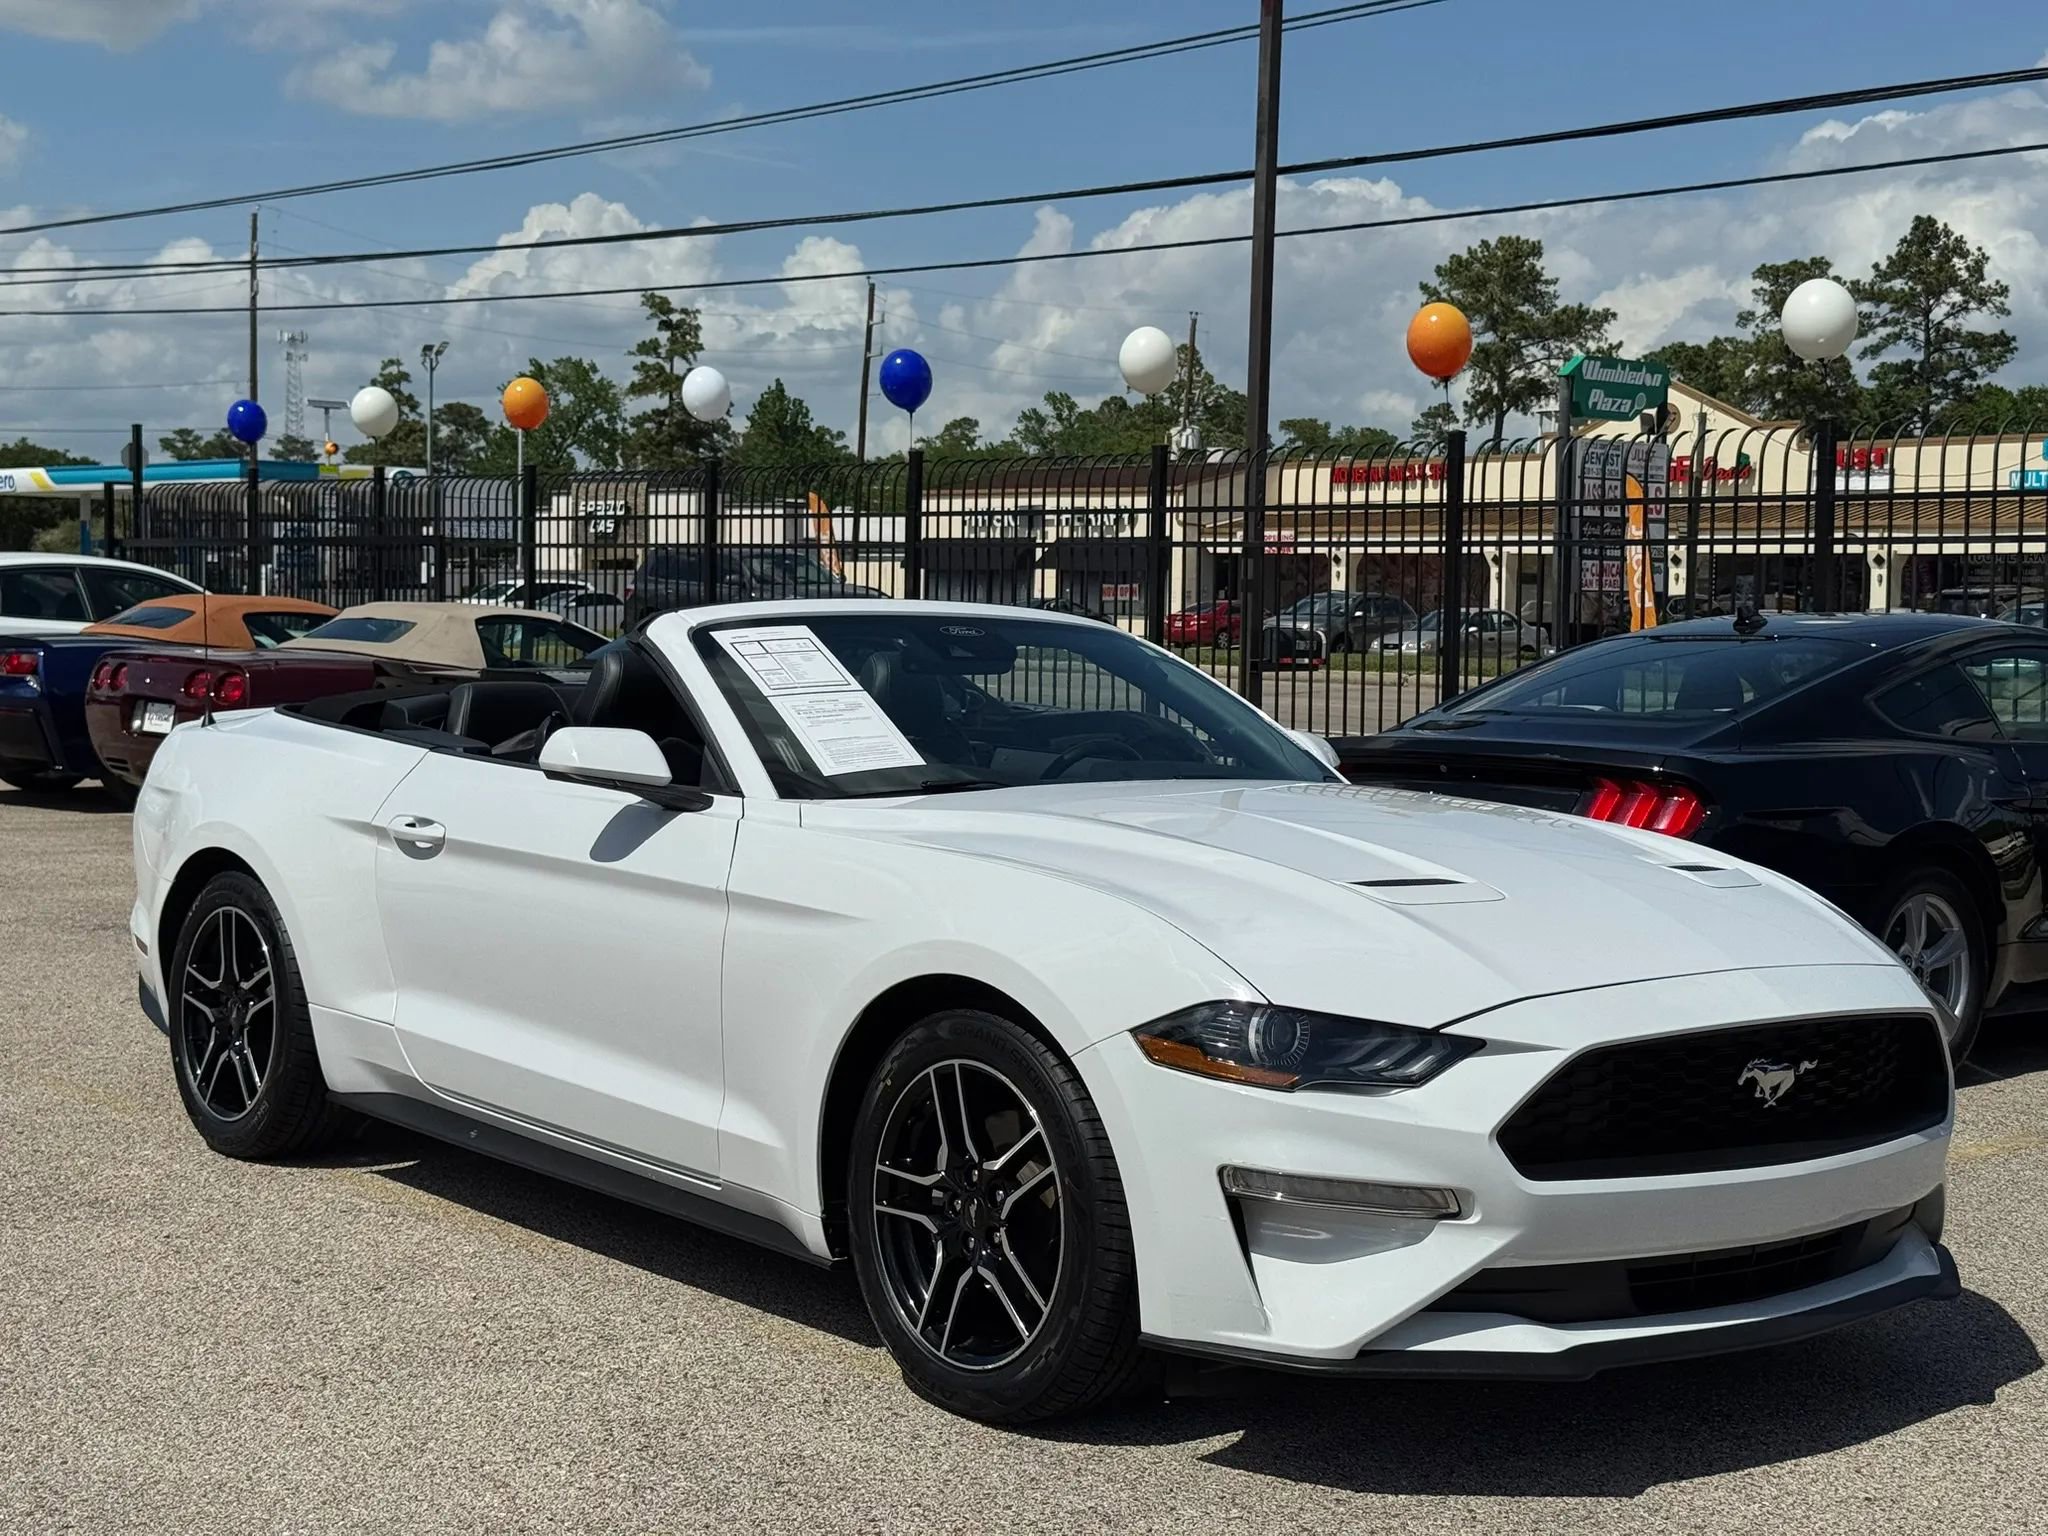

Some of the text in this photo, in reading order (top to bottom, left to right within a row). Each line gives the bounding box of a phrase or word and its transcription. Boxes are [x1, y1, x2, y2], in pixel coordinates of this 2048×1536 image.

[1582, 359, 1663, 387] Wimbledon
[1588, 388, 1633, 413] Plaza
[1583, 451, 1621, 467] DENTST
[1590, 561, 1620, 577] CLNICA
[1119, 586, 1138, 598] OPN
